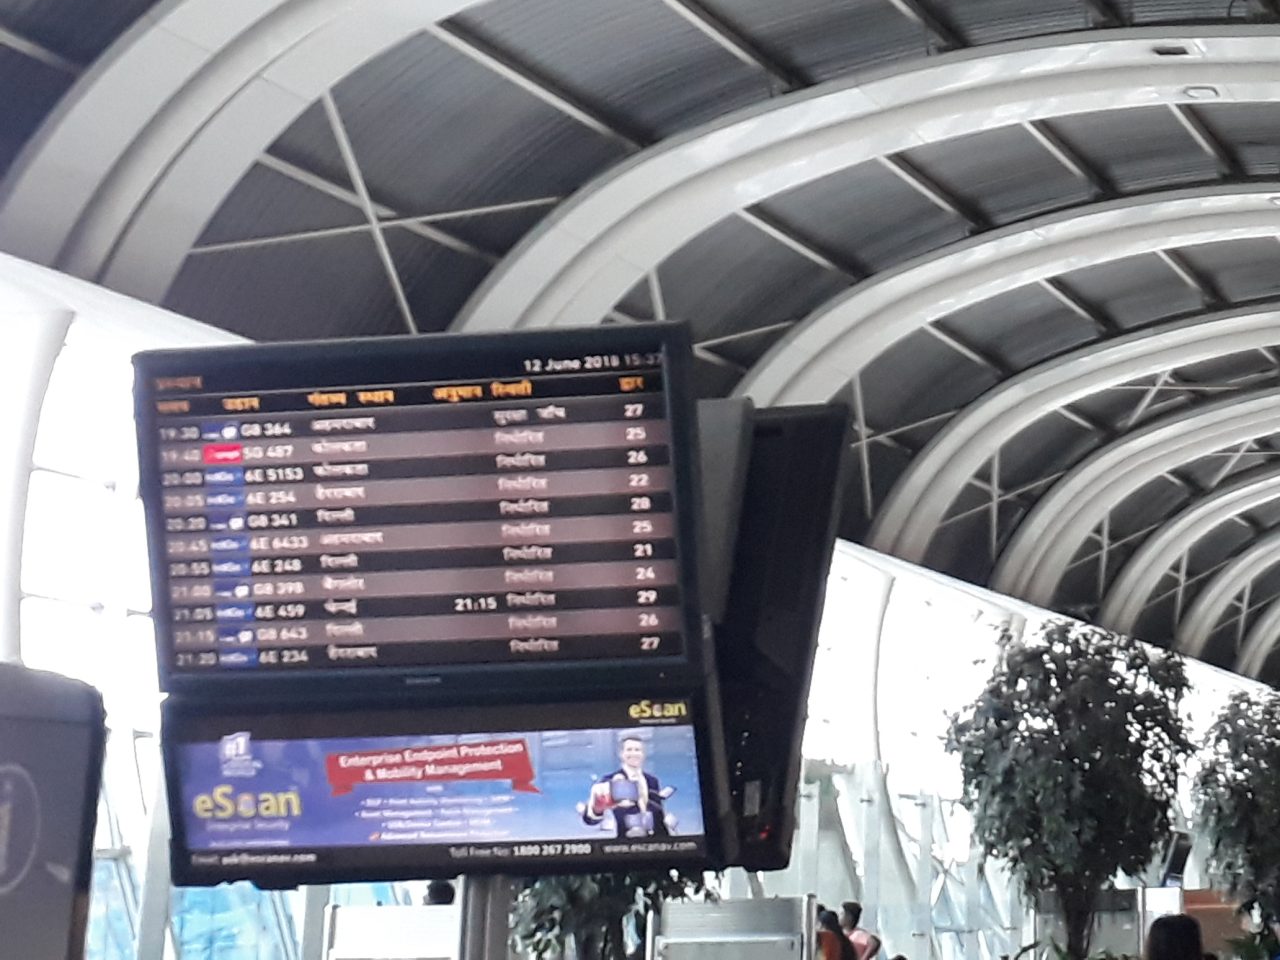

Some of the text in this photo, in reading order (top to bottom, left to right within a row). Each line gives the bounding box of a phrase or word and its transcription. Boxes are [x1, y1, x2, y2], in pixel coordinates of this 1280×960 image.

[523, 359, 542, 372] 12
[545, 358, 581, 371] June
[624, 403, 643, 417] 27
[625, 427, 646, 440] 25
[627, 450, 648, 464] 26
[629, 473, 649, 487] 22
[633, 520, 652, 533] 25
[633, 543, 653, 557] 21
[454, 596, 498, 611] 21:15
[637, 589, 658, 603] 29
[639, 613, 658, 627] 26
[640, 636, 660, 650] 27
[628, 699, 687, 719] eScan
[460, 742, 524, 757] Protection
[192, 784, 302, 819] eScan
